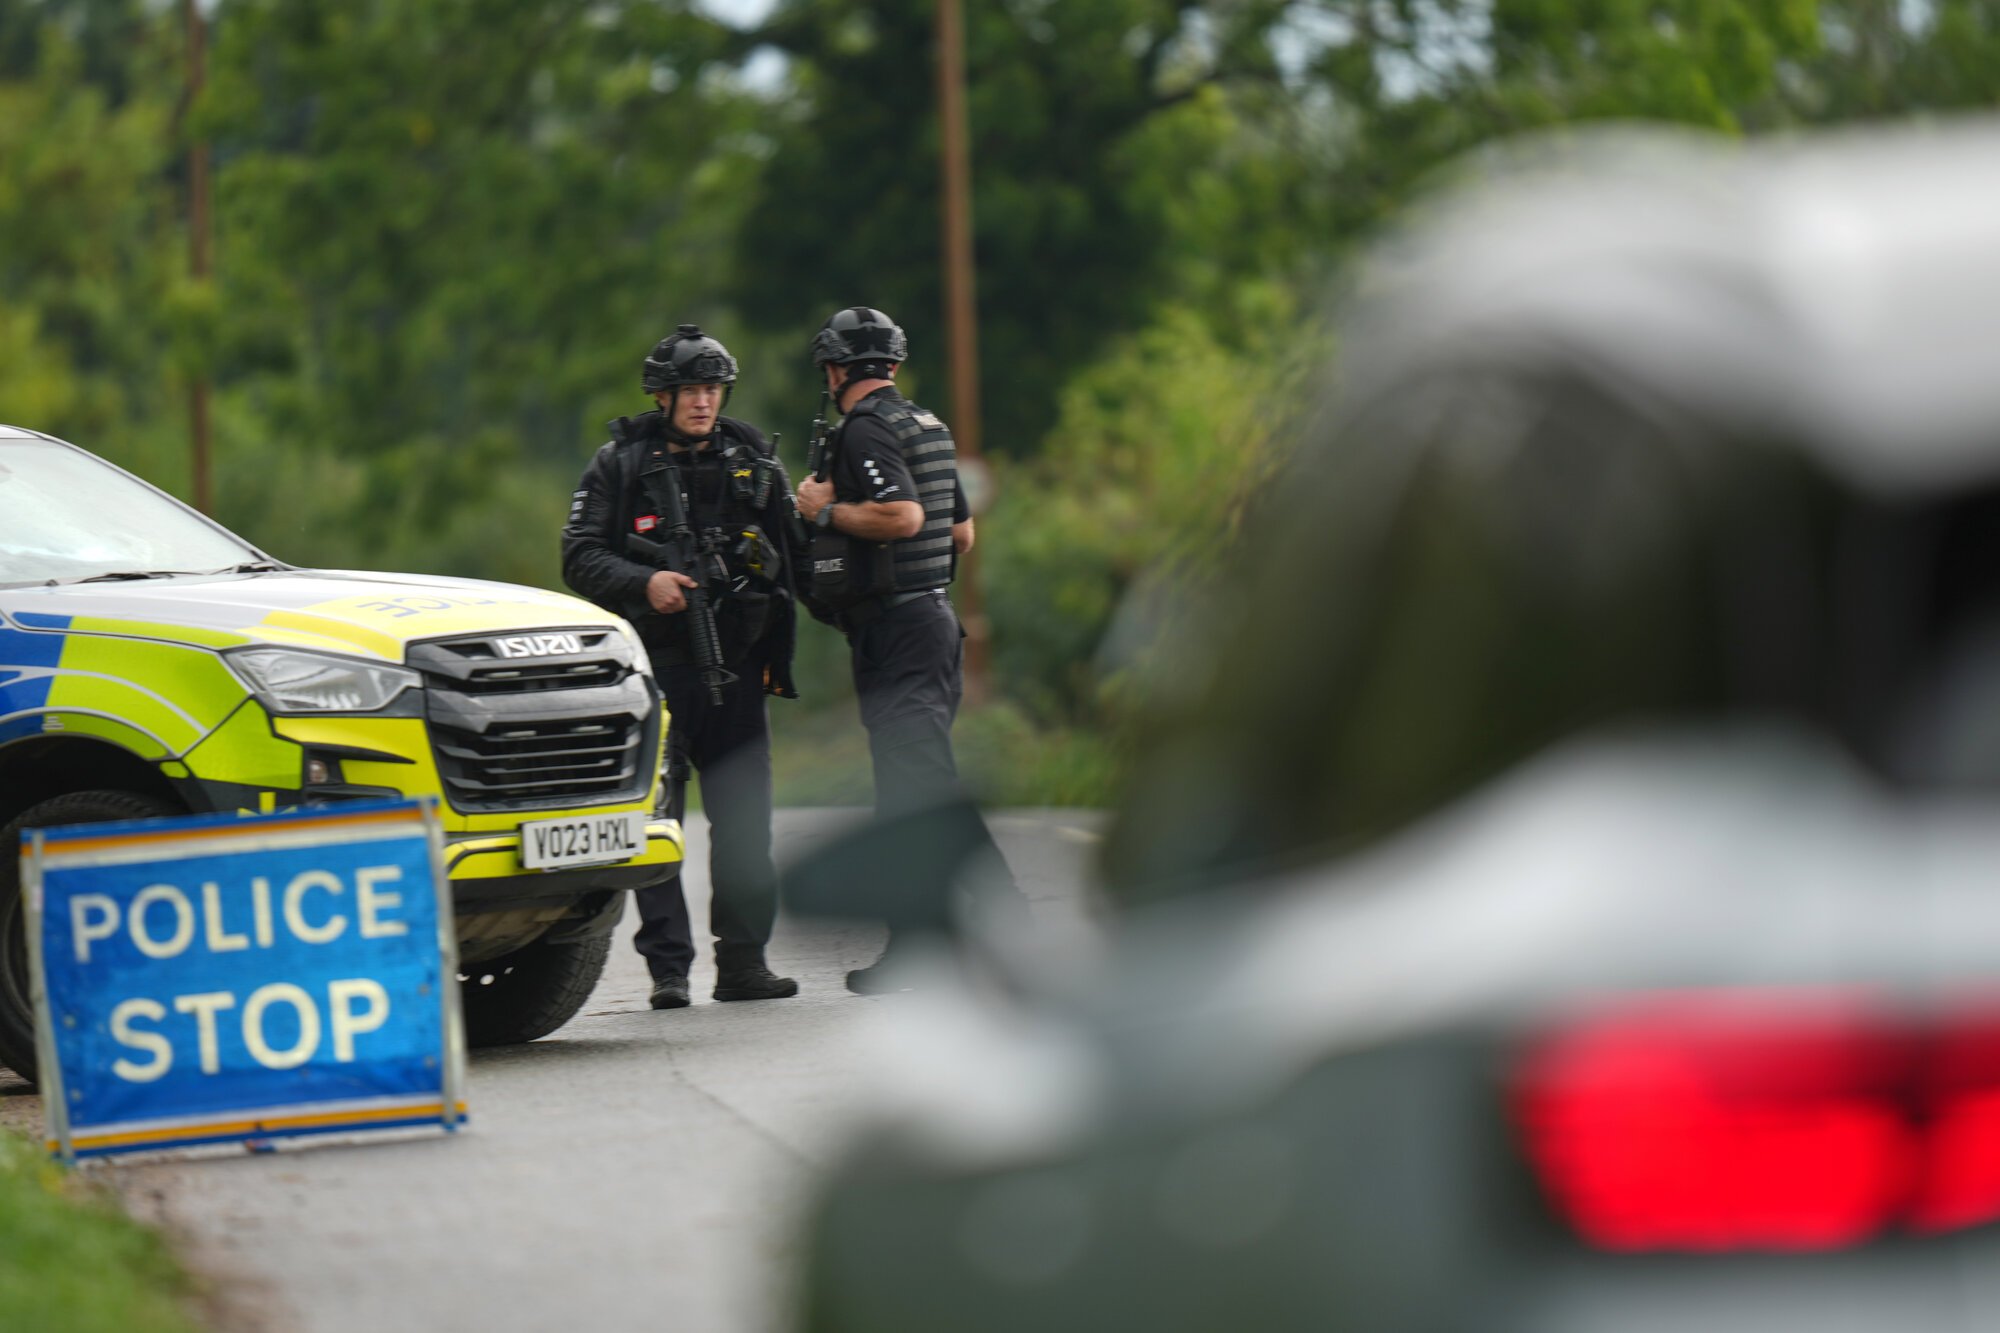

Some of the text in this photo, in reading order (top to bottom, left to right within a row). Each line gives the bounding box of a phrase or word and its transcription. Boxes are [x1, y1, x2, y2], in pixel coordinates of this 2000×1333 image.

[495, 634, 581, 658] ISUZU
[596, 818, 636, 852] HXL
[70, 865, 408, 963] POLICE
[109, 978, 390, 1083] STOP
